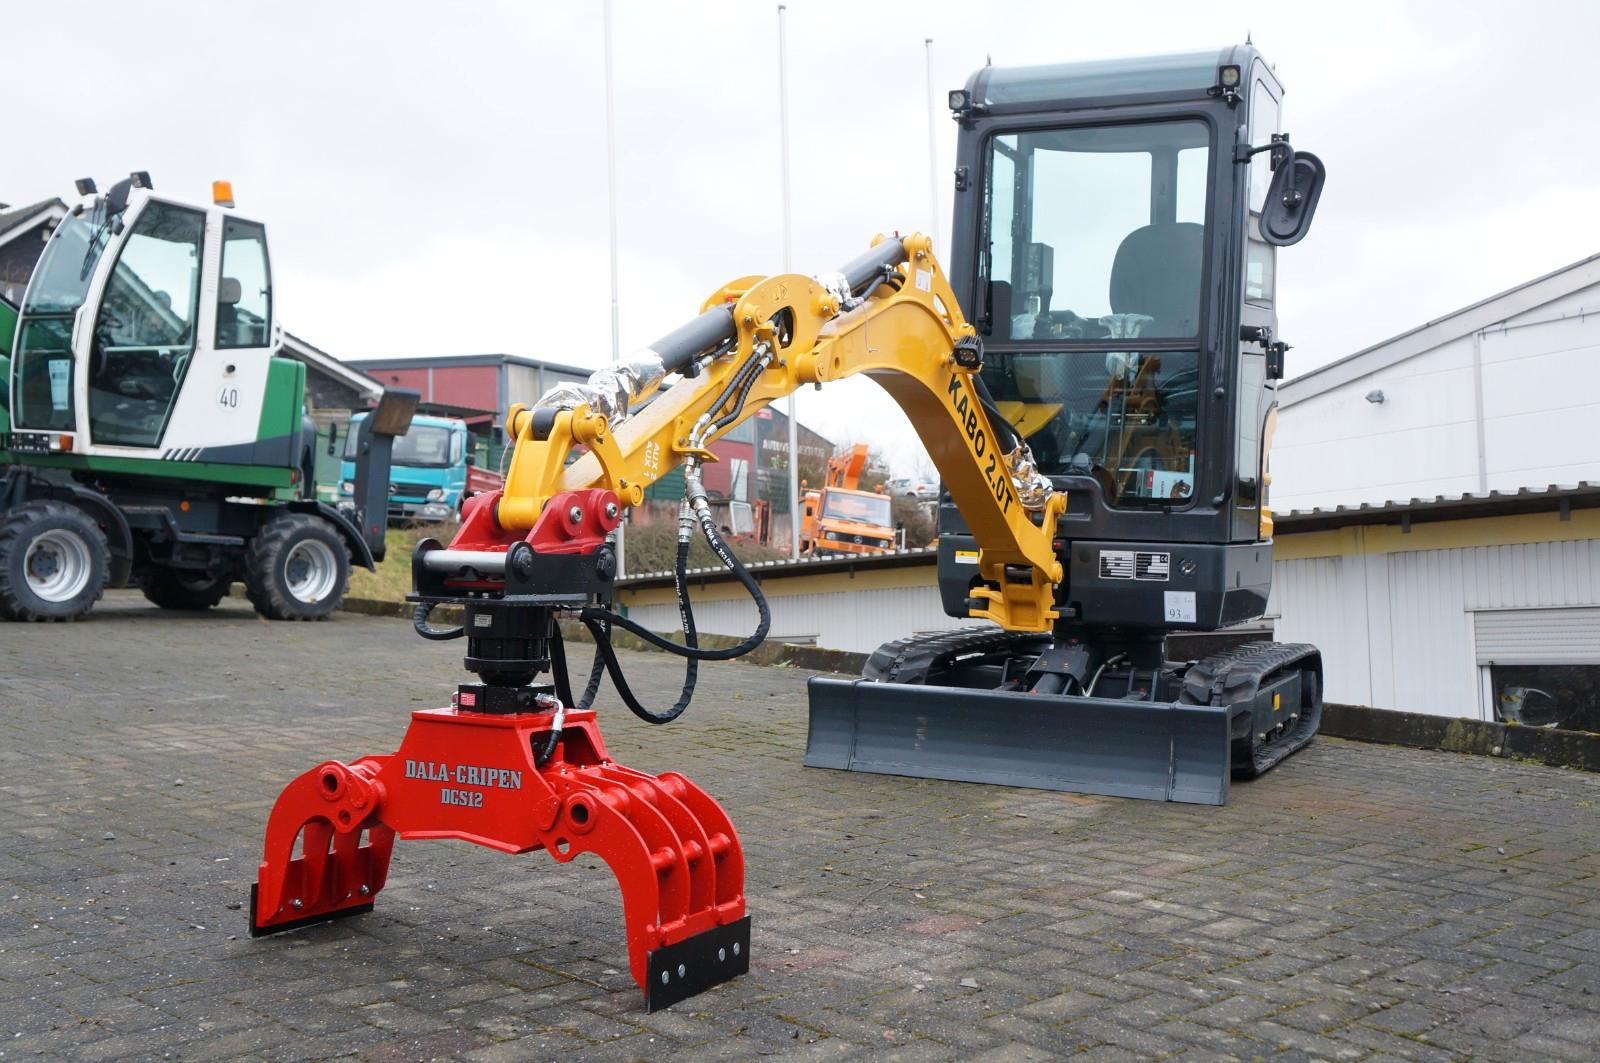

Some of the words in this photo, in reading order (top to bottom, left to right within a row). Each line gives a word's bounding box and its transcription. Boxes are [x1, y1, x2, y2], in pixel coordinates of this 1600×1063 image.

[219, 388, 238, 408] 40
[644, 440, 652, 467] AUX
[948, 373, 986, 458] KABO
[984, 453, 1014, 515] 2.0T
[651, 442, 660, 471] AUX
[650, 472, 657, 481] 2
[1169, 608, 1181, 620] 93
[405, 759, 522, 789] DALA-GRIPEN
[441, 788, 483, 808] DGS12
